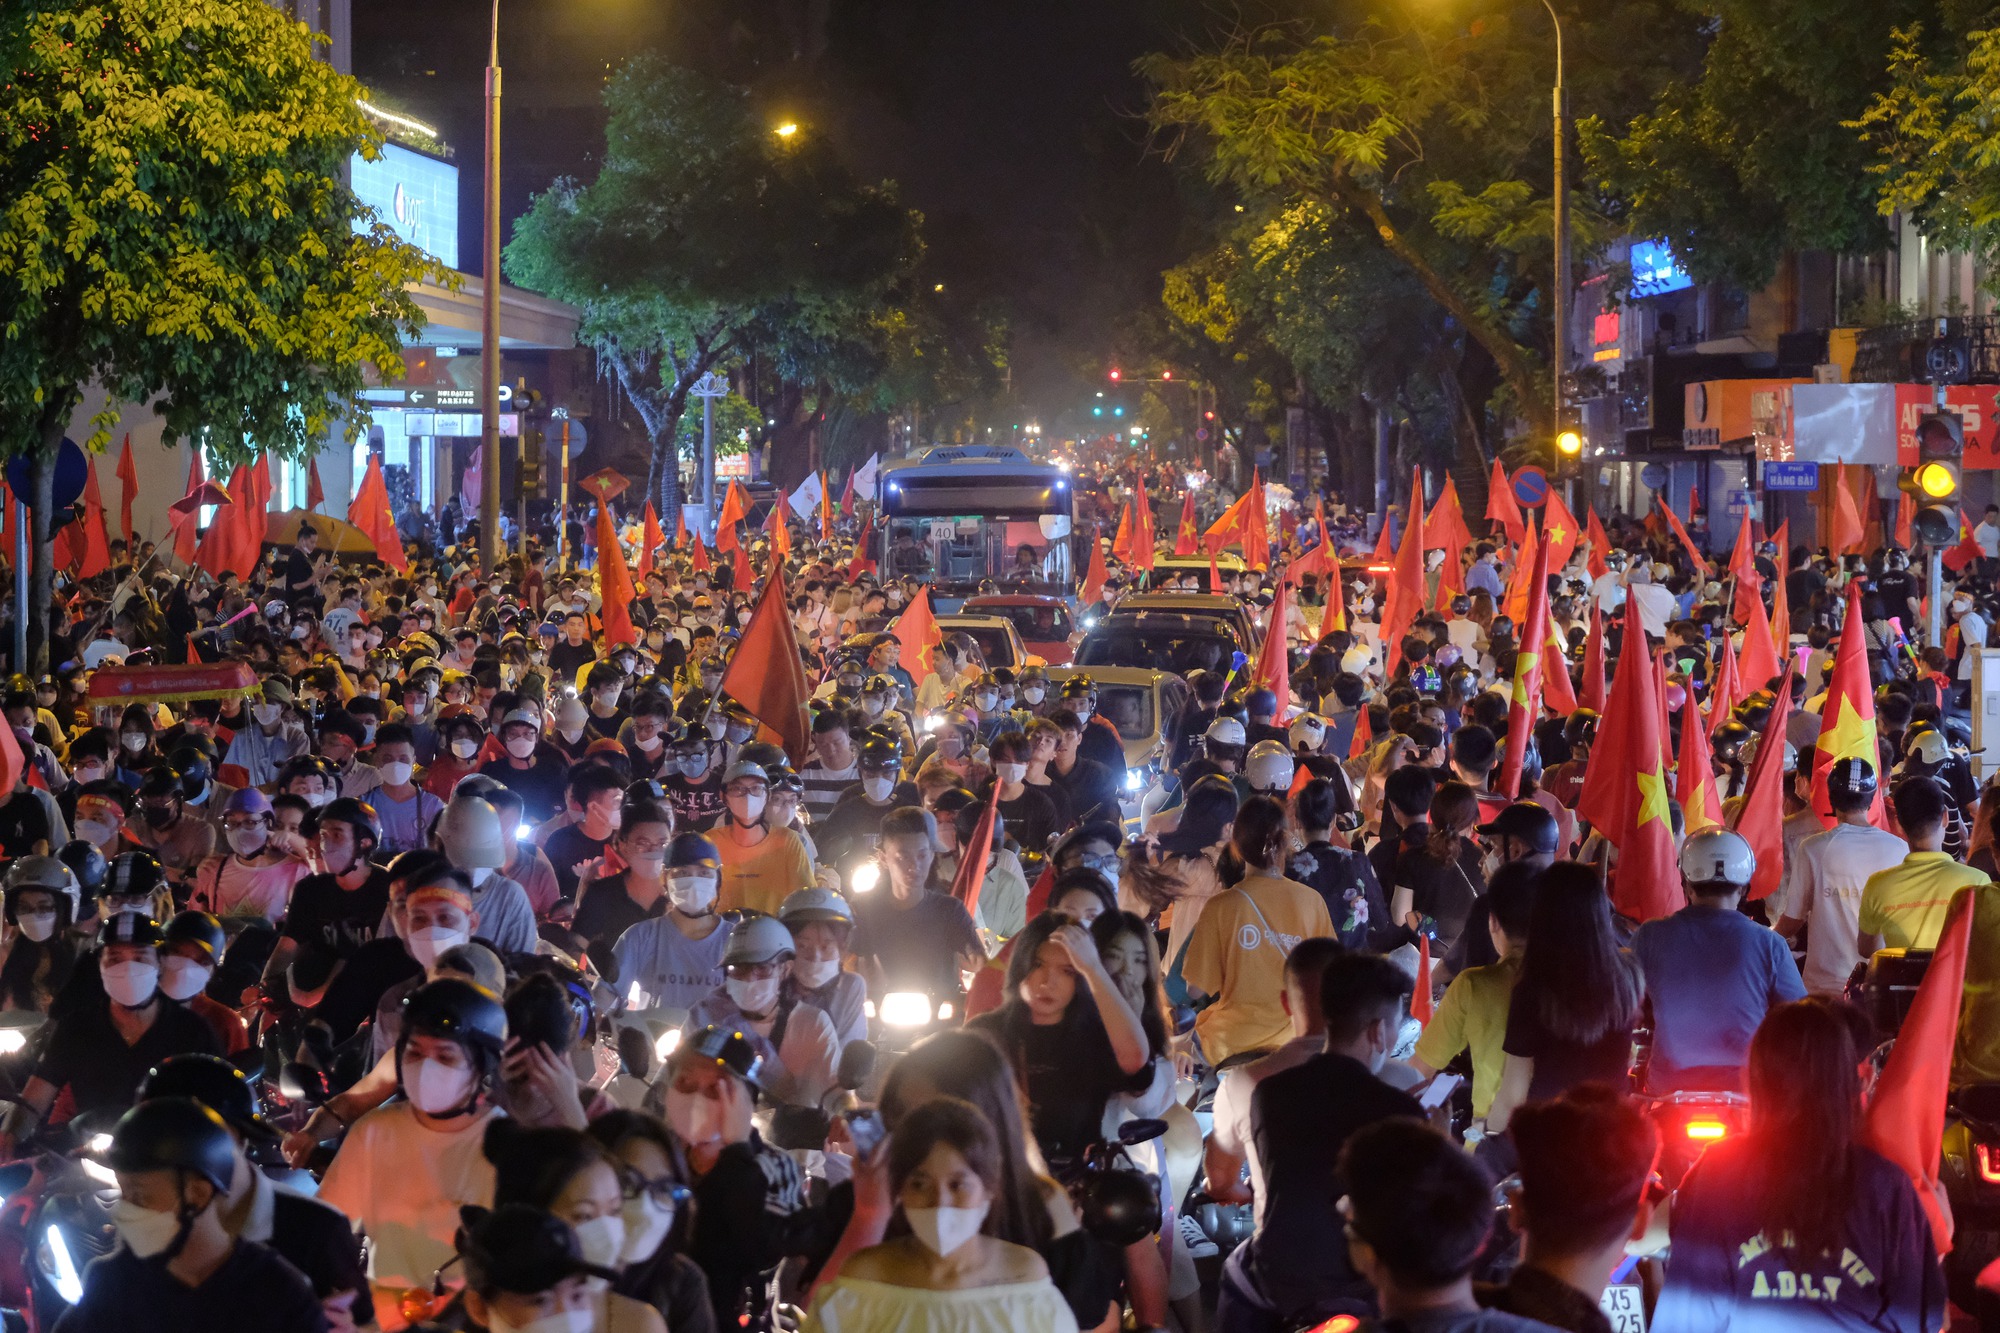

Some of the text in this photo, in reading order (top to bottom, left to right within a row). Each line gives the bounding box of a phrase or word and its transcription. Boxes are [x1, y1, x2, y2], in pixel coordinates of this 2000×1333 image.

[437, 397, 474, 405] PARKING
[1770, 473, 1814, 486] HÀNG BÀI
[935, 527, 952, 540] 40
